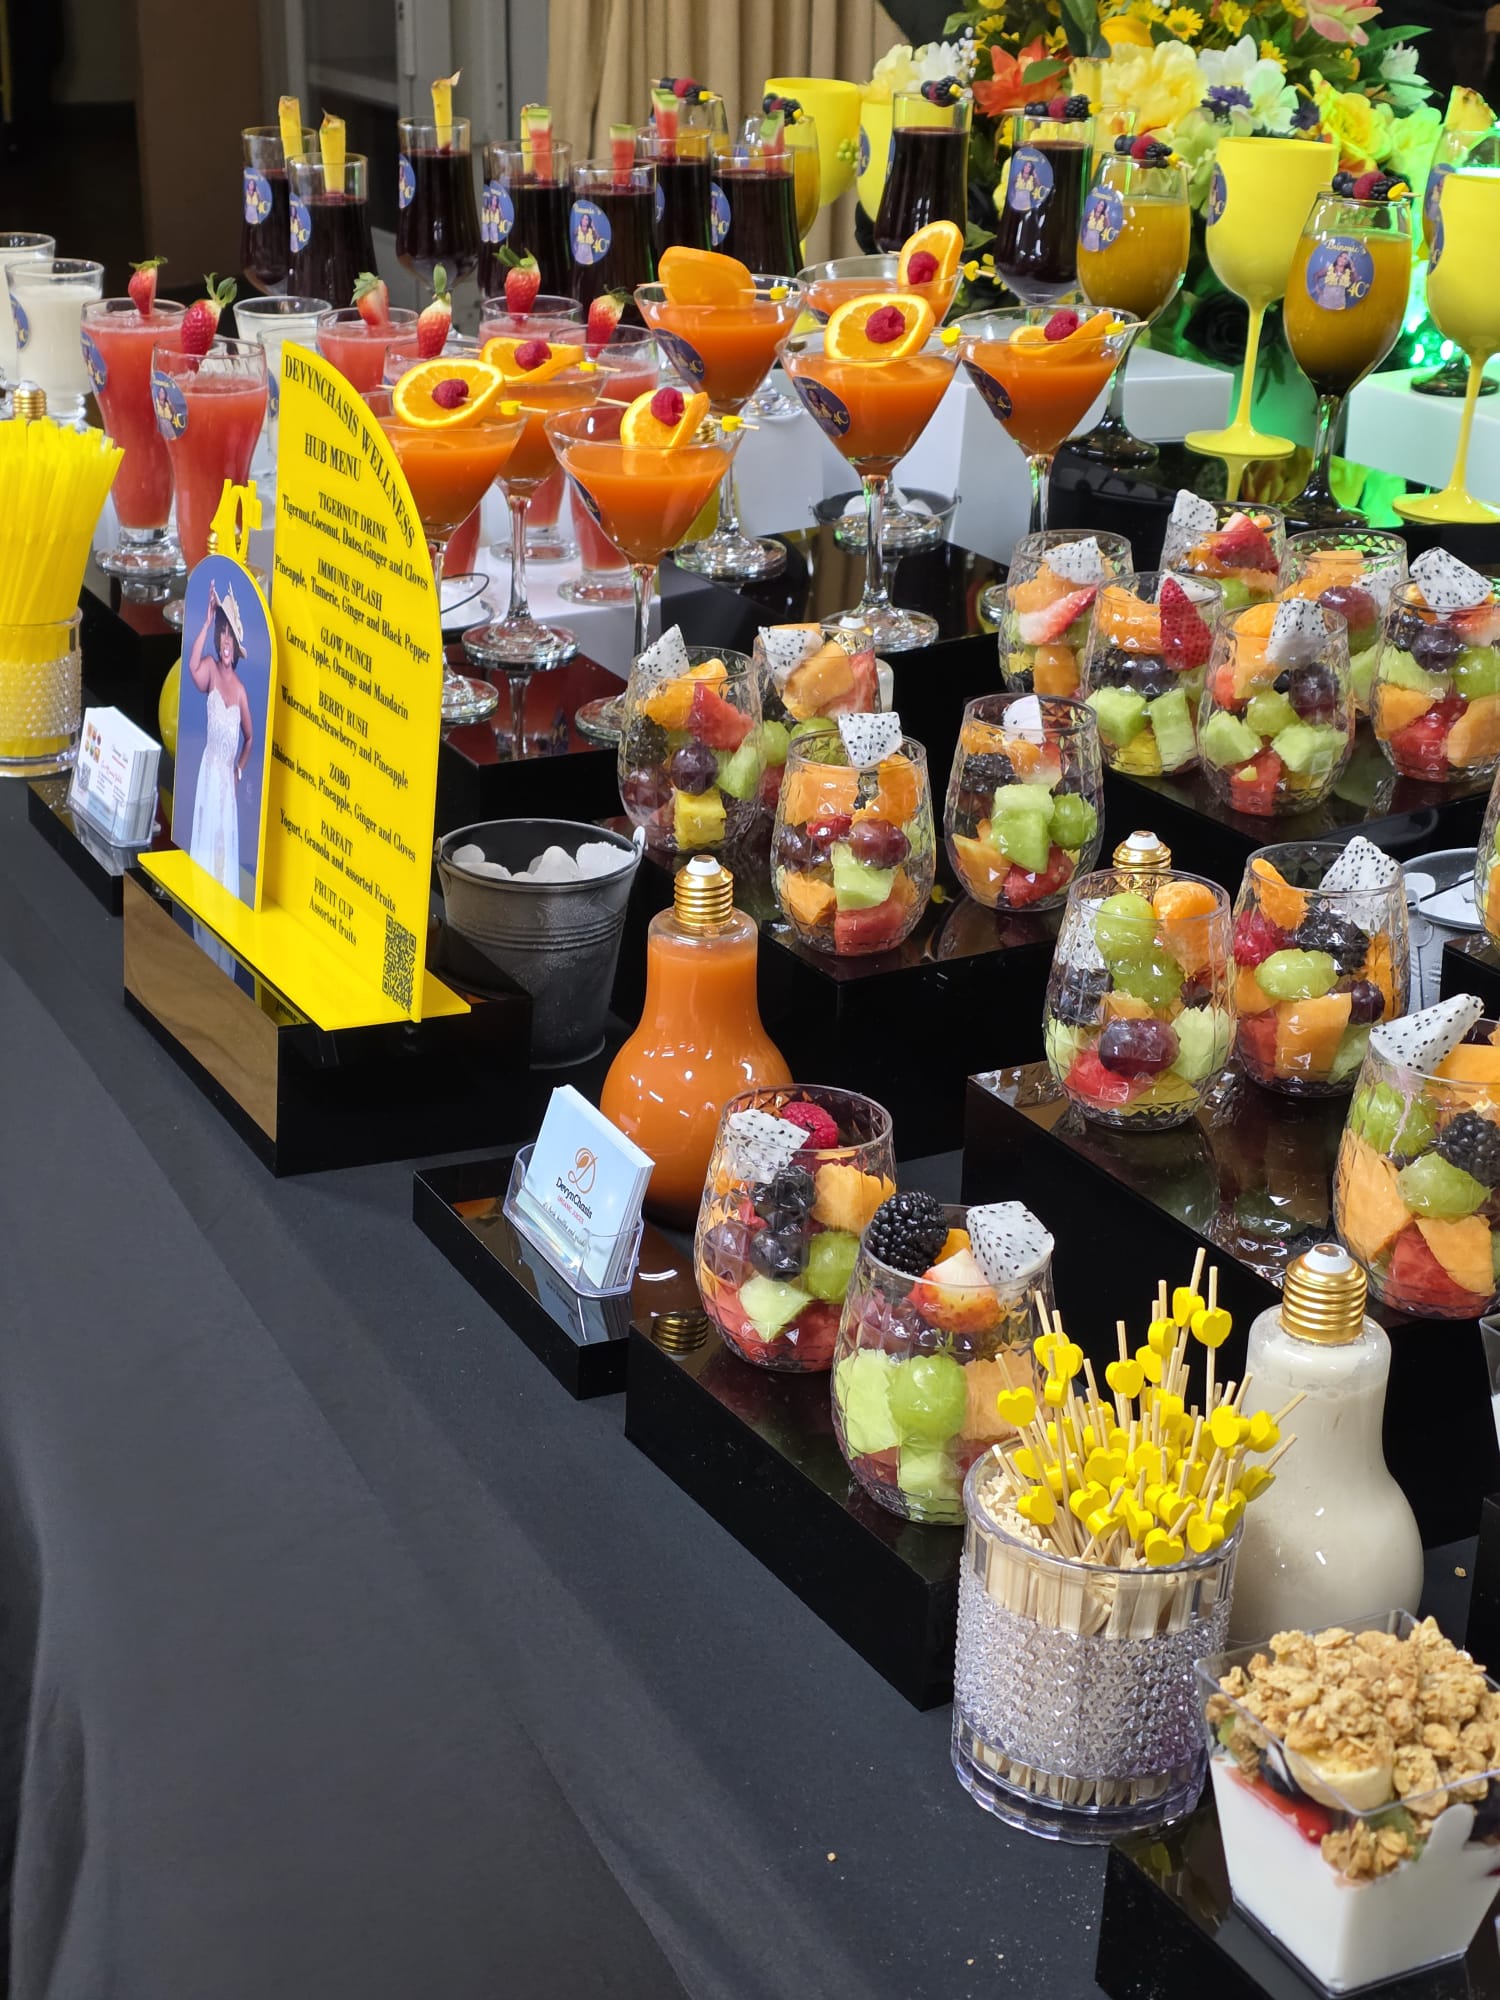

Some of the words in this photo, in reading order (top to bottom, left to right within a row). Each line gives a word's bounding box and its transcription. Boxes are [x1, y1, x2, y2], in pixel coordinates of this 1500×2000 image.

[285, 354, 359, 438] DEVYNCHASIS
[362, 424, 415, 549] WELLNESS
[304, 432, 327, 464] HUB
[329, 445, 362, 482] MENU
[318, 491, 359, 529] TIGERNUT
[360, 516, 388, 545] DRINK
[317, 558, 350, 592] IMMUNE
[351, 578, 383, 612] SPLASH
[389, 558, 403, 575] and
[404, 563, 429, 591] Cloves
[320, 626, 344, 653] GLOW
[344, 642, 373, 673] PUNCH
[342, 595, 365, 625] Ginger
[366, 616, 380, 633] and
[382, 619, 403, 647] Black
[404, 632, 431, 664] Pepper
[332, 657, 357, 688] Orange
[358, 677, 372, 696] and
[373, 683, 409, 720] Mandarin
[318, 690, 346, 722] BERRY
[346, 708, 369, 738] RUSH
[329, 761, 351, 791] ZOBO
[358, 746, 372, 764] and
[373, 749, 409, 790] Pineapple
[320, 819, 354, 857] PARFAIT
[354, 802, 377, 834] Ginger
[378, 827, 392, 844] and
[393, 832, 416, 863] Cloves
[304, 828, 330, 861] Granola
[331, 856, 344, 873] and
[345, 866, 373, 895] assorted
[374, 884, 396, 913] Fruits
[308, 896, 337, 929] Assorted
[338, 920, 357, 947] fruits
[313, 877, 337, 908] FRUIT
[338, 896, 354, 921] CUP
